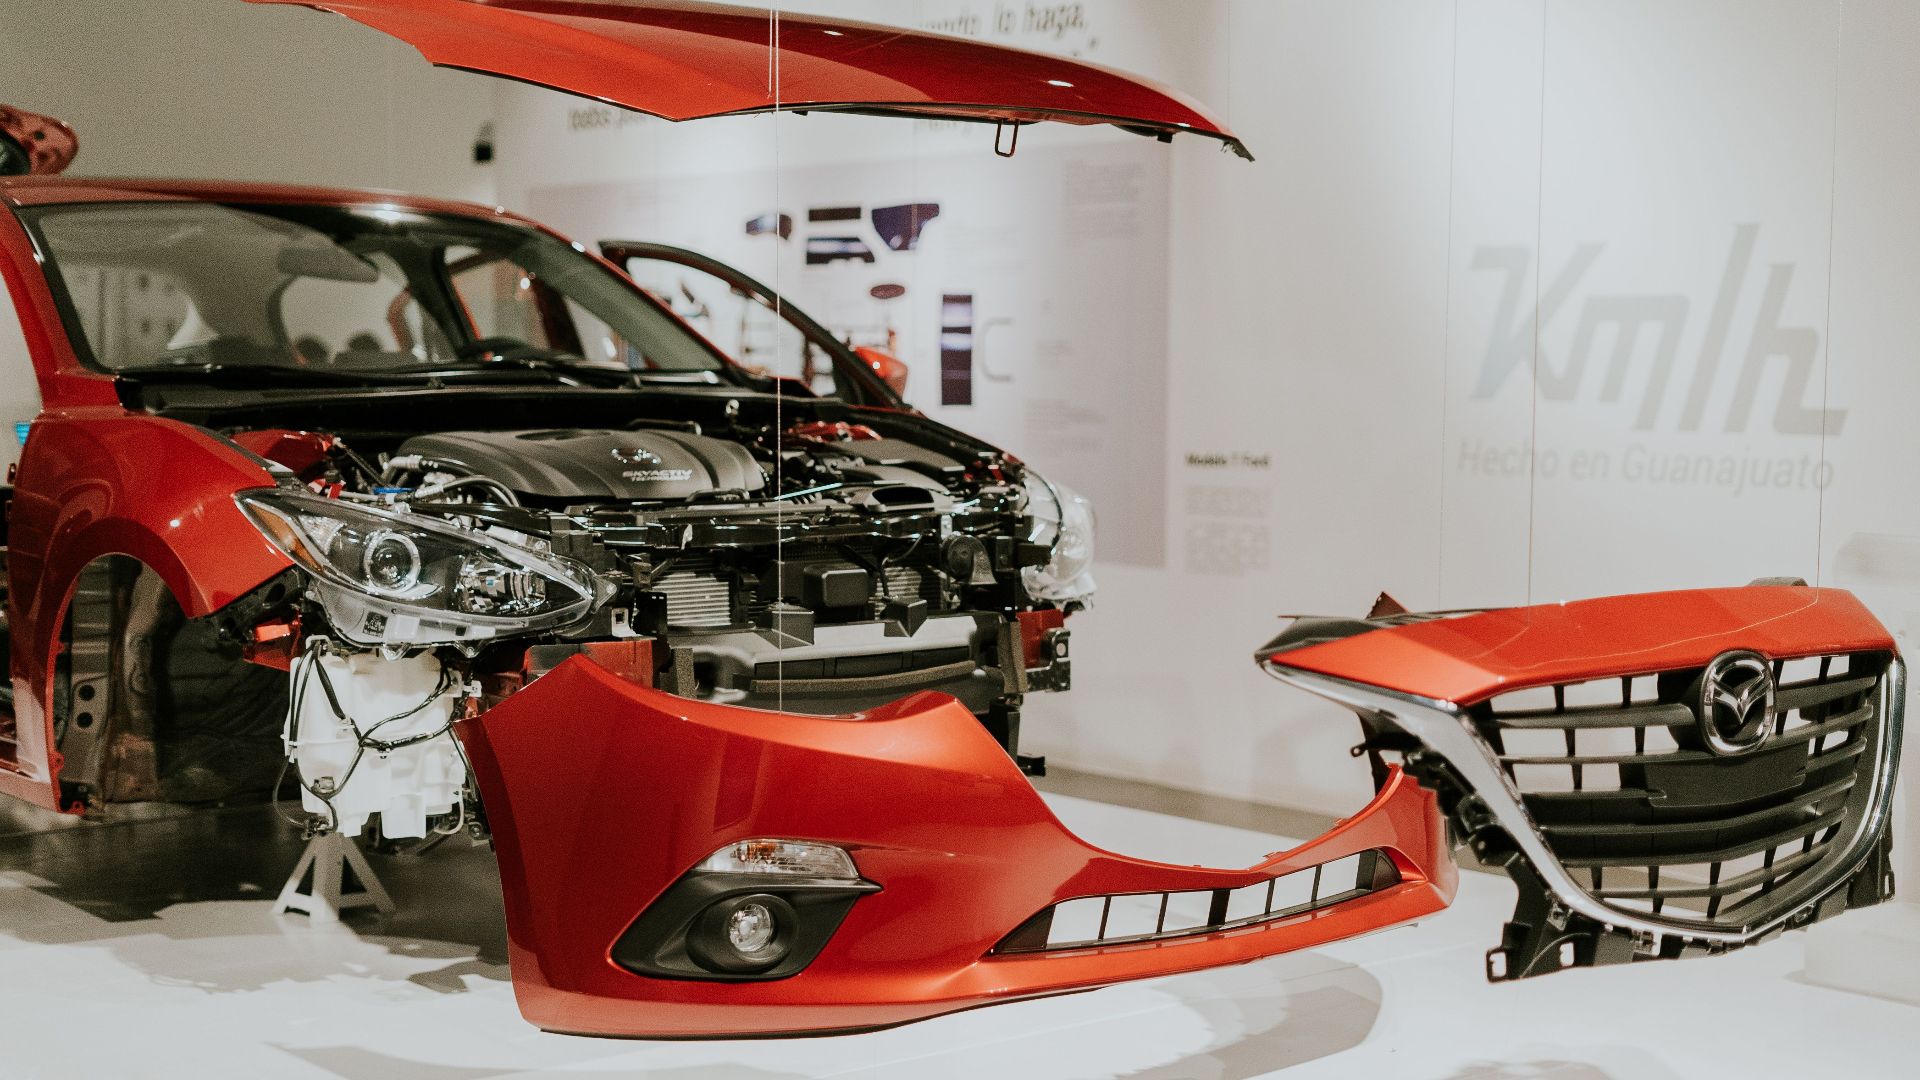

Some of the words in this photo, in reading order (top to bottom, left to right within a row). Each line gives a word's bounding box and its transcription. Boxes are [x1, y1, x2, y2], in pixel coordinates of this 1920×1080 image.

[622, 469, 692, 478] SKYACTIV
[1457, 438, 1559, 480] Hecho
[1570, 448, 1609, 480] en
[1621, 442, 1835, 494] Guanajuato
